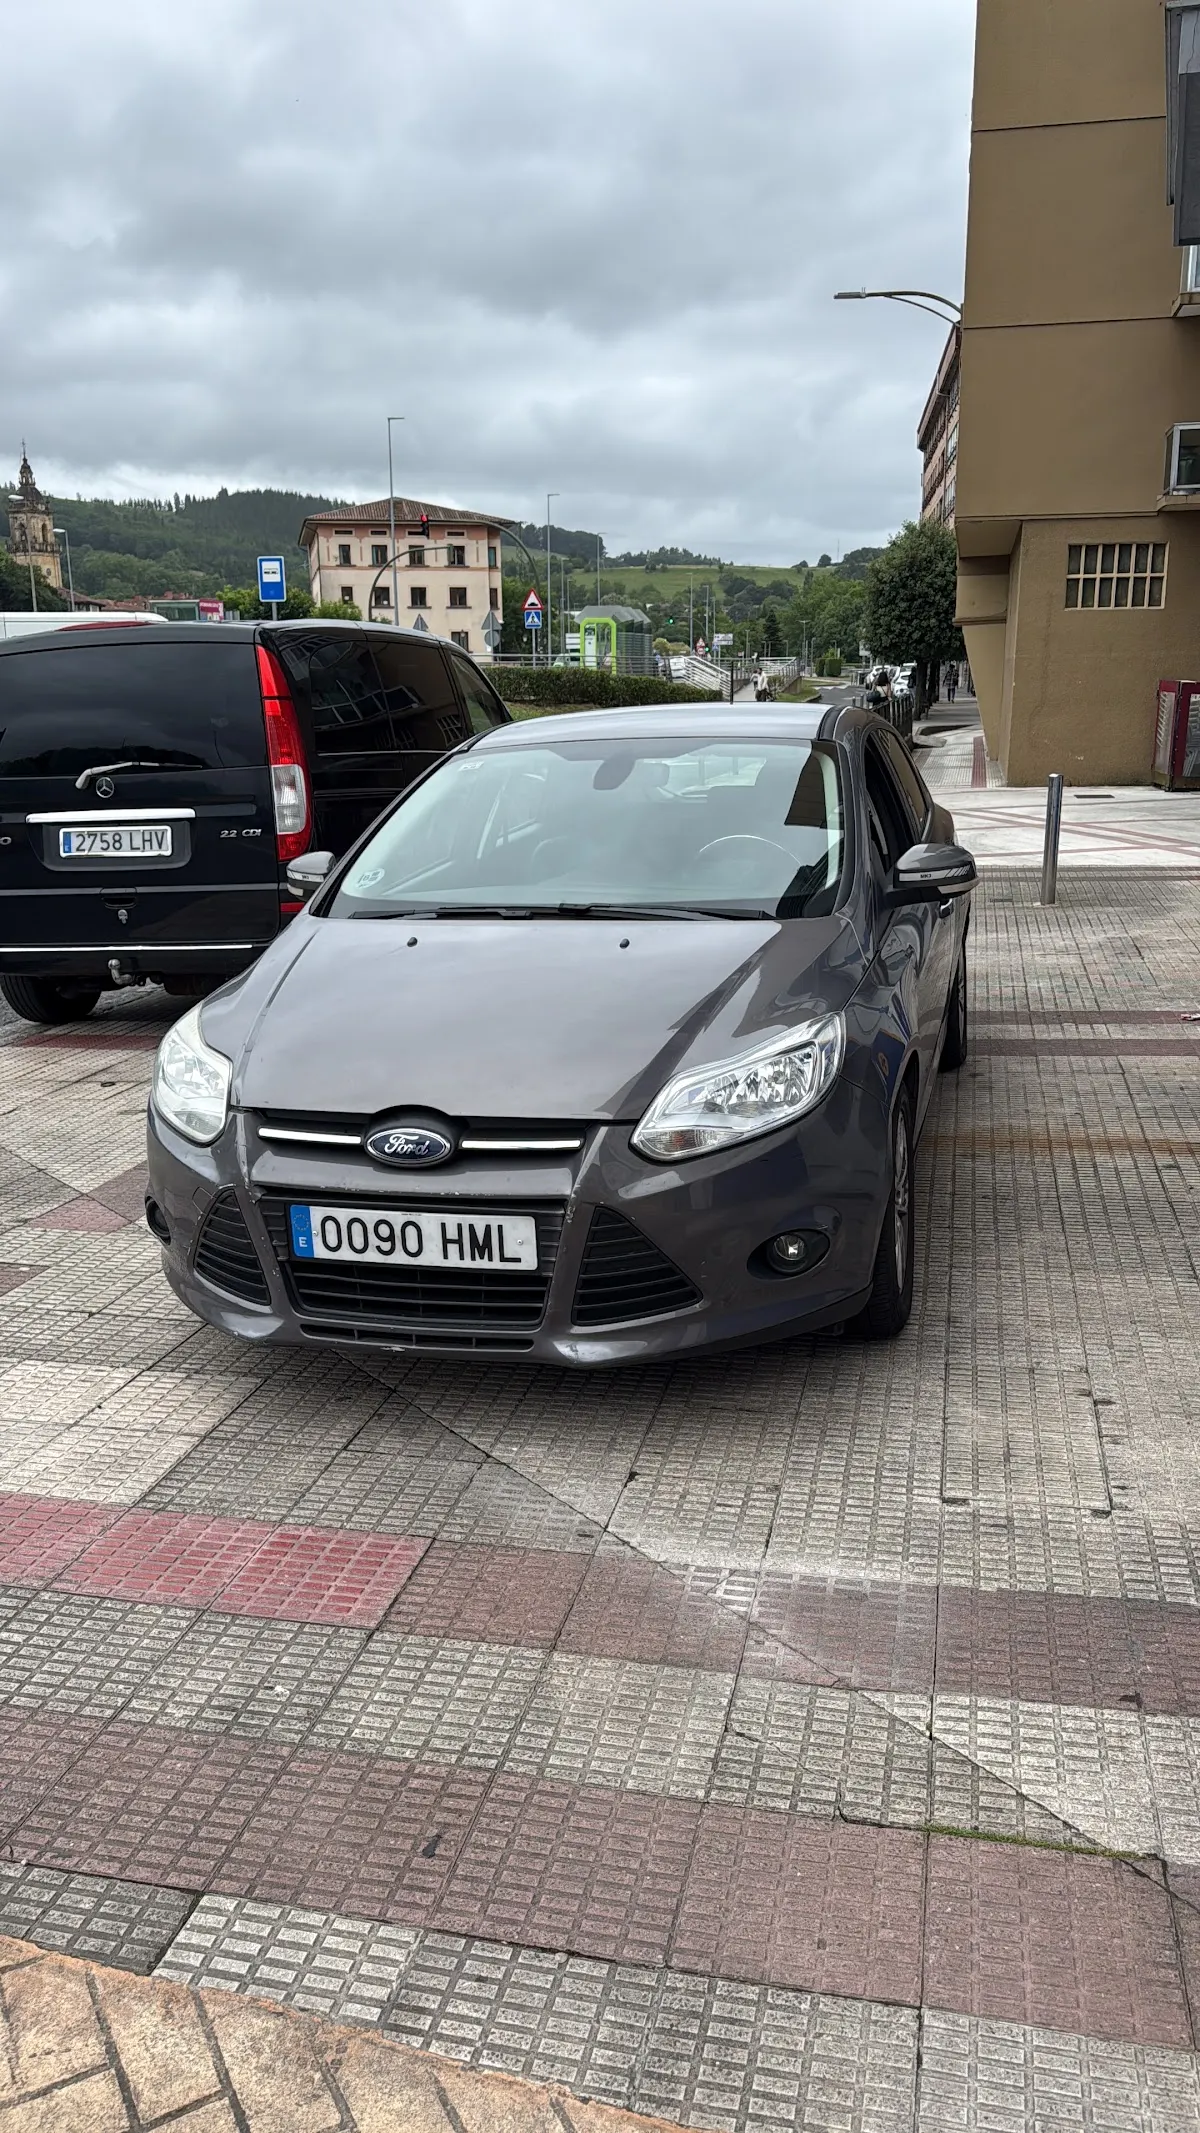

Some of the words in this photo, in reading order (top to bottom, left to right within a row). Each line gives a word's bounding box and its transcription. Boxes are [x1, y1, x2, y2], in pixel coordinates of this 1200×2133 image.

[75, 832, 123, 854] 2758
[129, 831, 165, 852] LHV
[241, 828, 262, 837] CDI
[384, 1133, 431, 1156] Ford
[299, 1236, 308, 1248] E
[320, 1215, 424, 1258] 0090
[440, 1222, 522, 1263] HML
